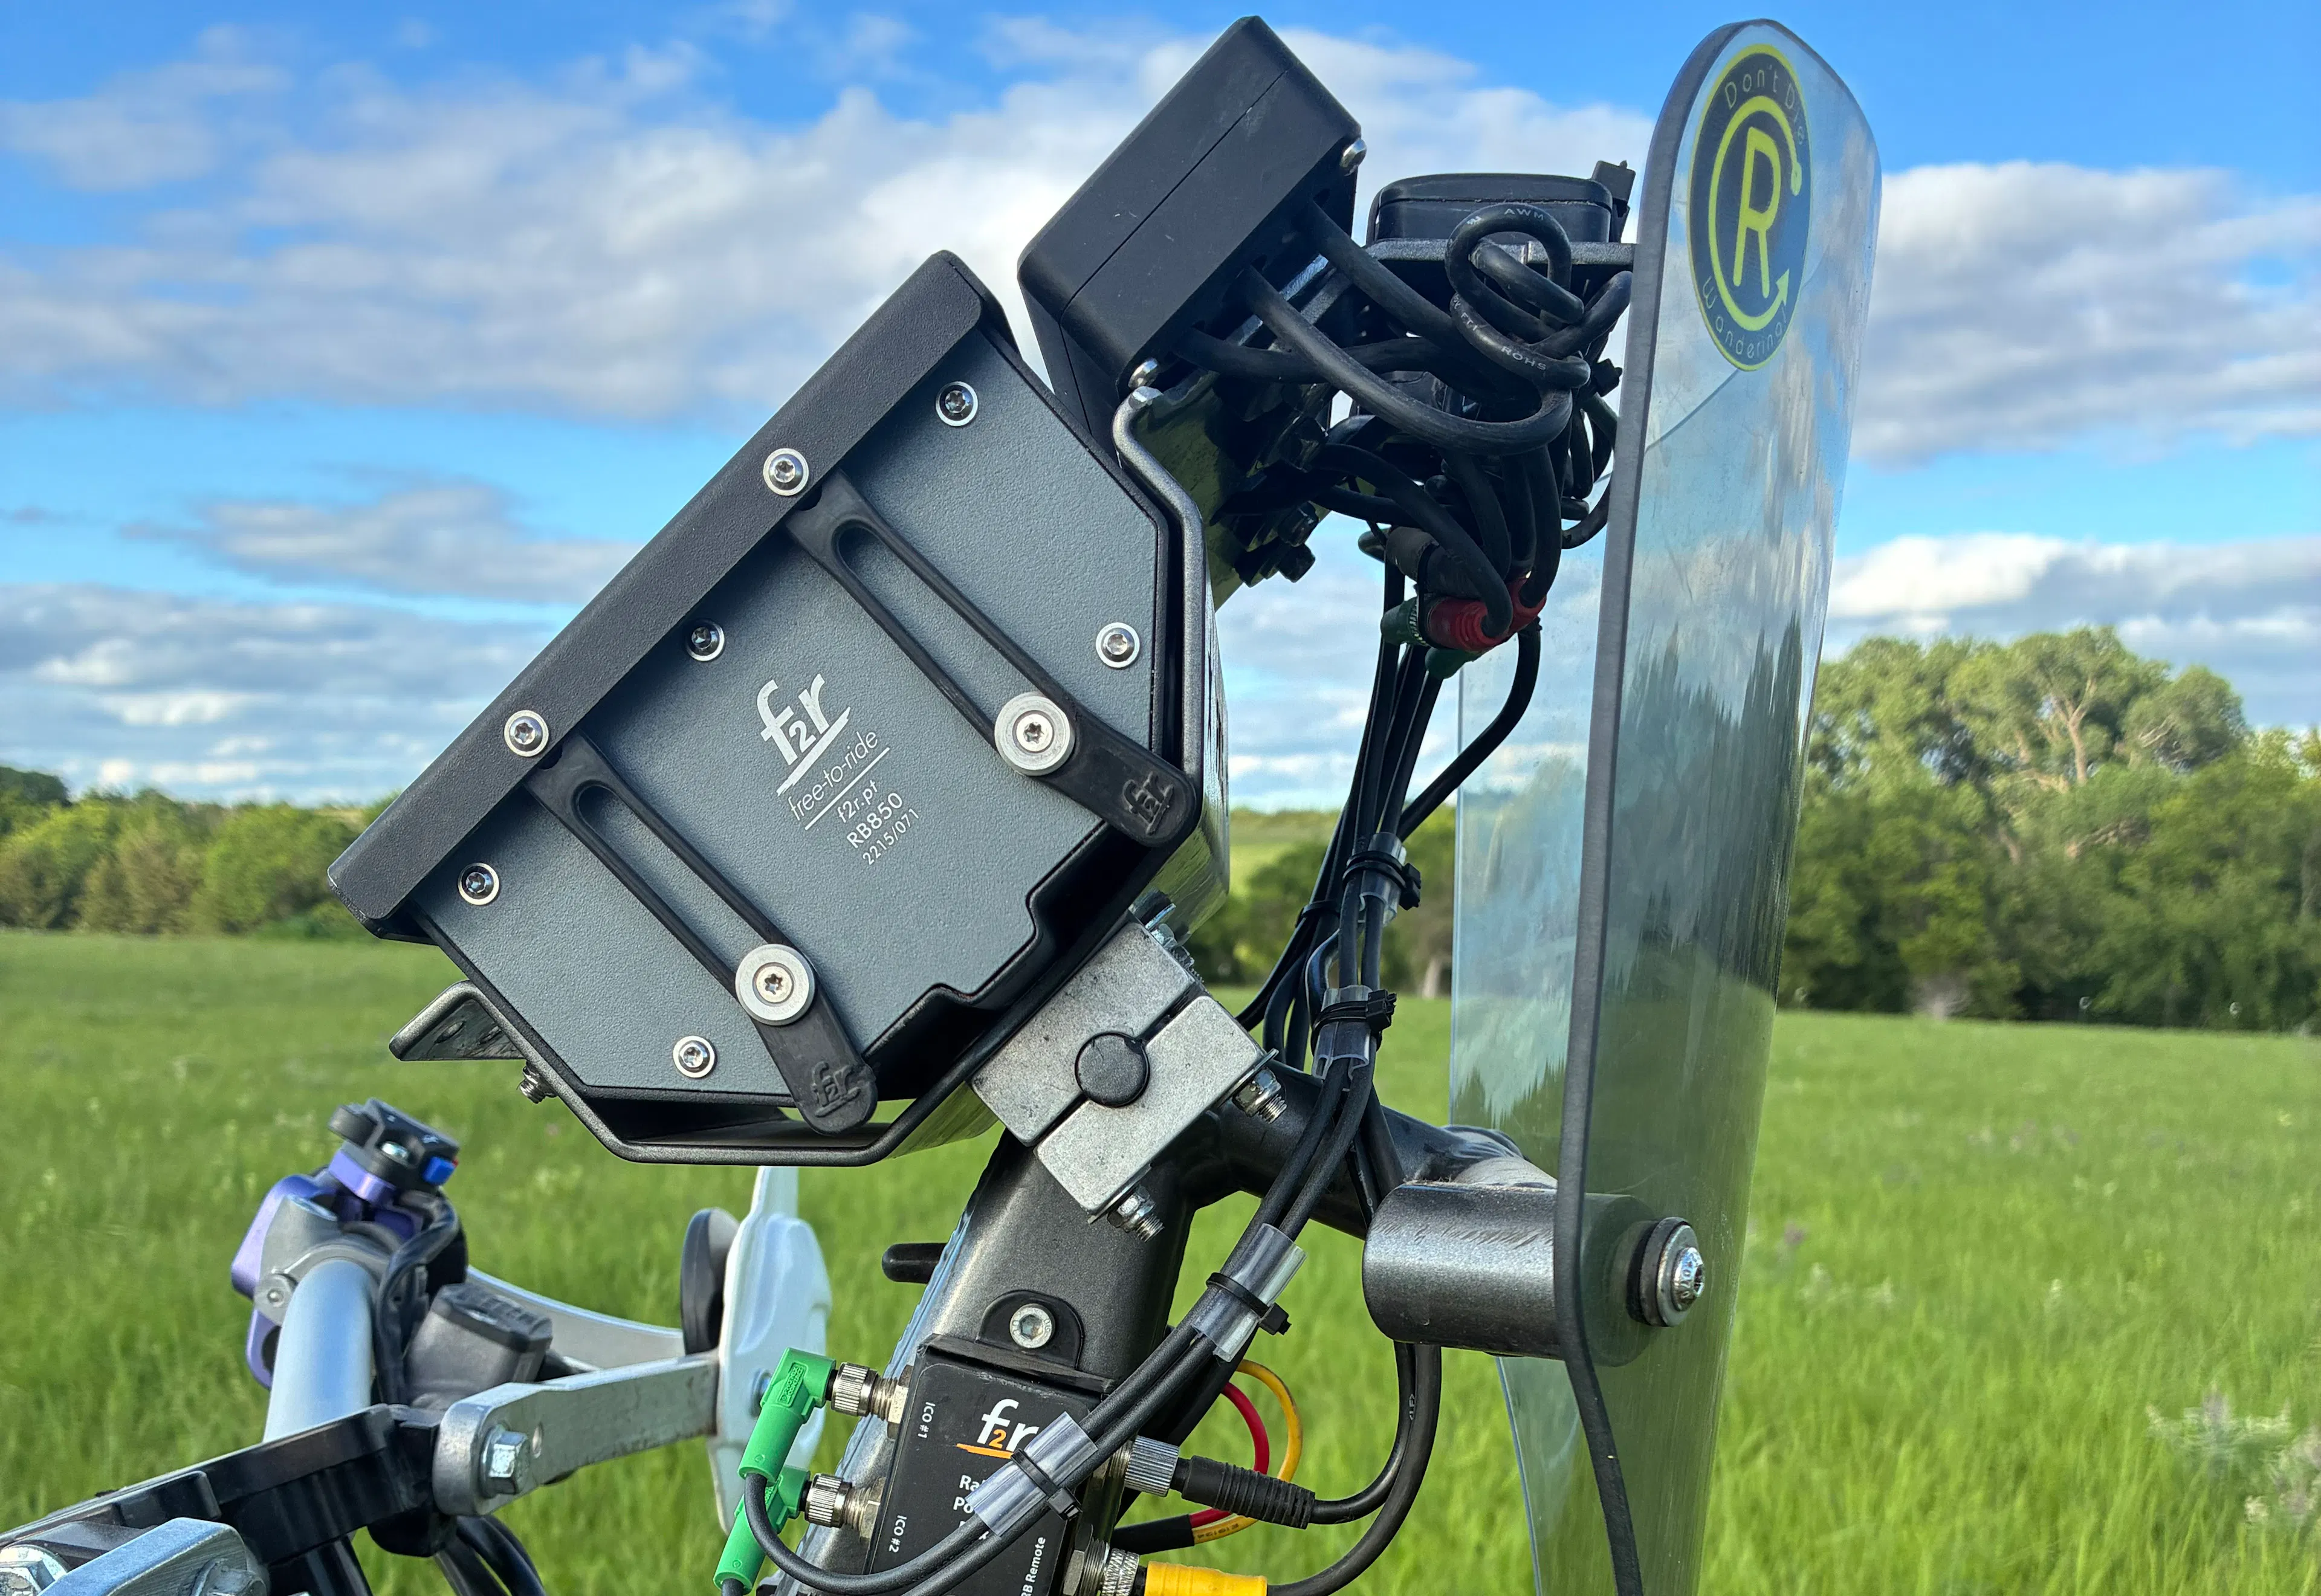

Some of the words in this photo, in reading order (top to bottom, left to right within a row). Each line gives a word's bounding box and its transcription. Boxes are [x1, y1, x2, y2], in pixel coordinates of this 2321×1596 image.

[1504, 208, 1544, 221] AWM
[1733, 126, 1781, 299] R
[1501, 346, 1547, 370] ROHS
[756, 673, 830, 766] f2r
[788, 731, 878, 821] free-to-ride
[837, 780, 879, 823] f2r.pt
[846, 792, 903, 849] RB850
[862, 808, 919, 865] 2215/071
[918, 1424, 930, 1439] #1
[922, 1401, 936, 1423] ICO
[977, 1398, 1040, 1452] f2r
[889, 1537, 901, 1553] #2
[893, 1515, 907, 1536] ICO
[1025, 1537, 1046, 1583] Remote
